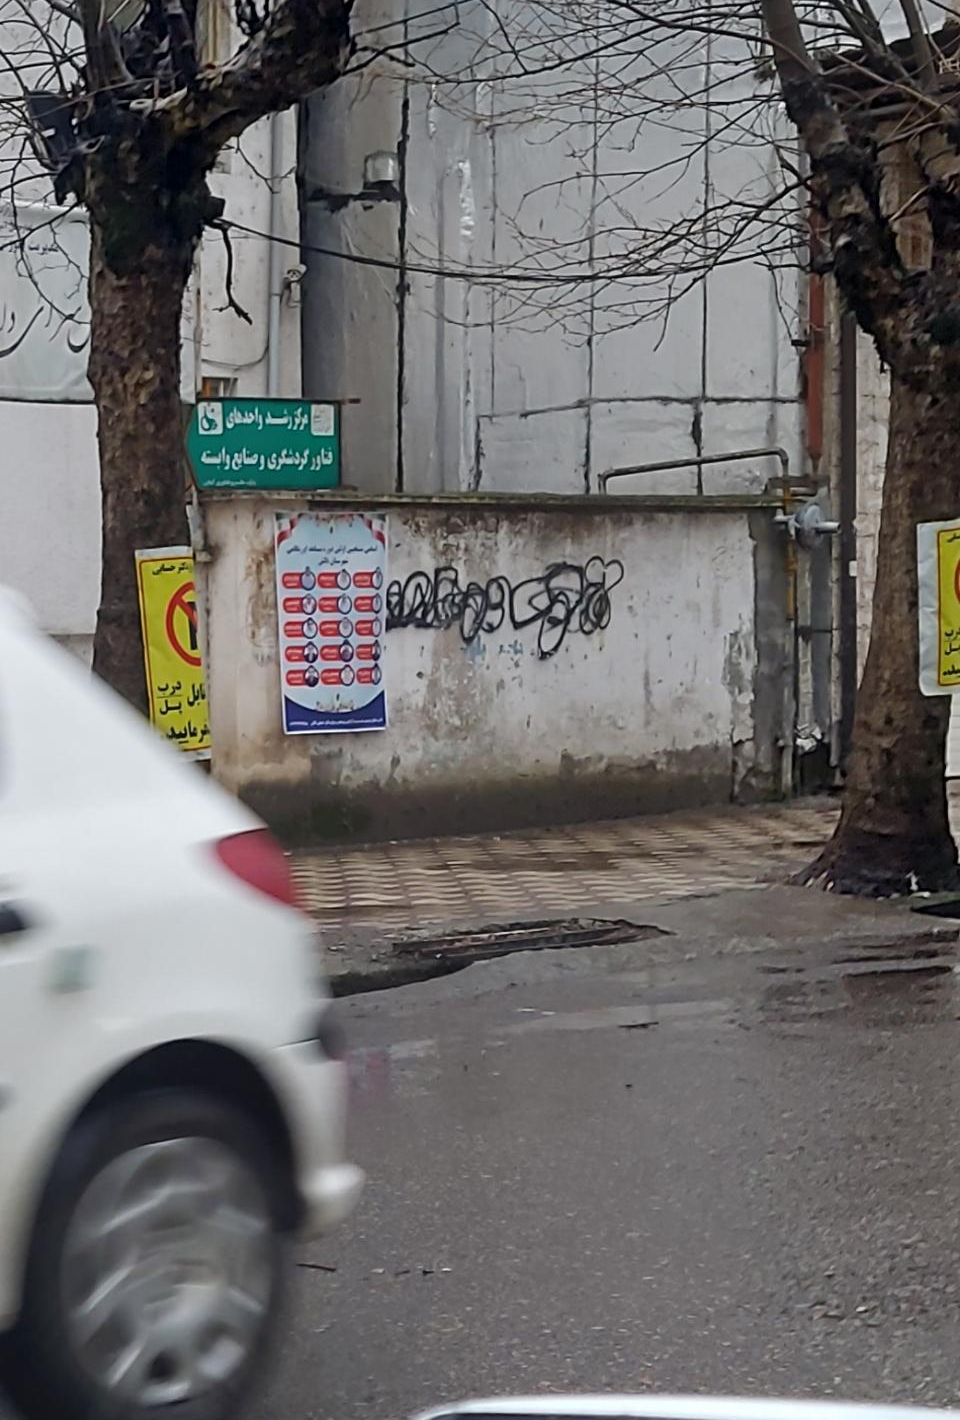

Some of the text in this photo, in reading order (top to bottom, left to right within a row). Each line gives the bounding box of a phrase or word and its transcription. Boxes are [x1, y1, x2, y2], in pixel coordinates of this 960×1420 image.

[225, 406, 309, 430] مرکز رشد واحدهای
[201, 446, 333, 471] فناور گردشگری و صنایع وابسته
[157, 681, 182, 695] درب
